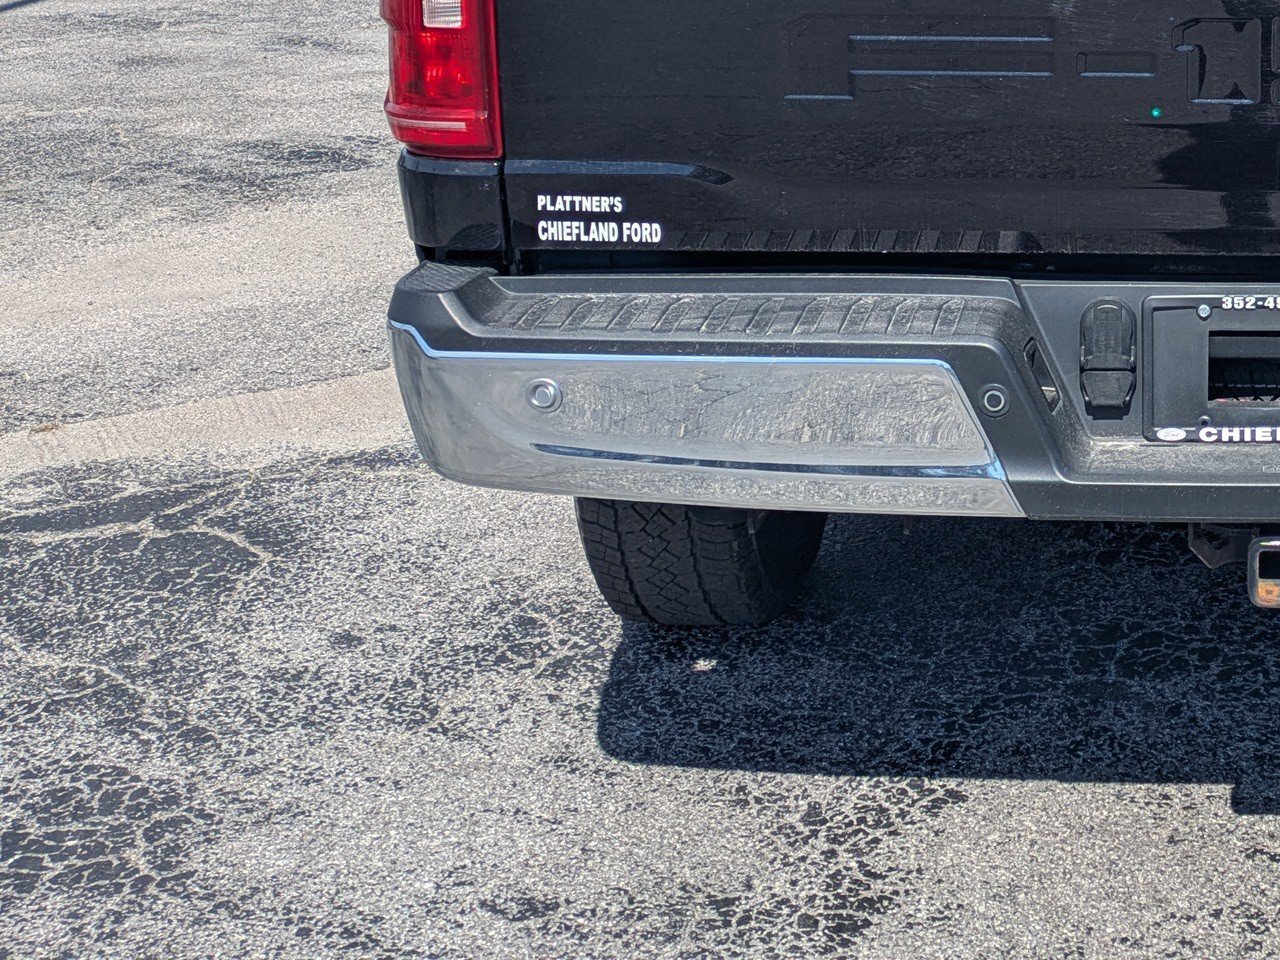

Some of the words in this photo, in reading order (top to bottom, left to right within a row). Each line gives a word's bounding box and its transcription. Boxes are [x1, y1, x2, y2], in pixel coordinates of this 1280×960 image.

[537, 195, 623, 213] PLATTNER'S
[537, 220, 619, 242] CHIEFLAND
[622, 222, 662, 243] FORD
